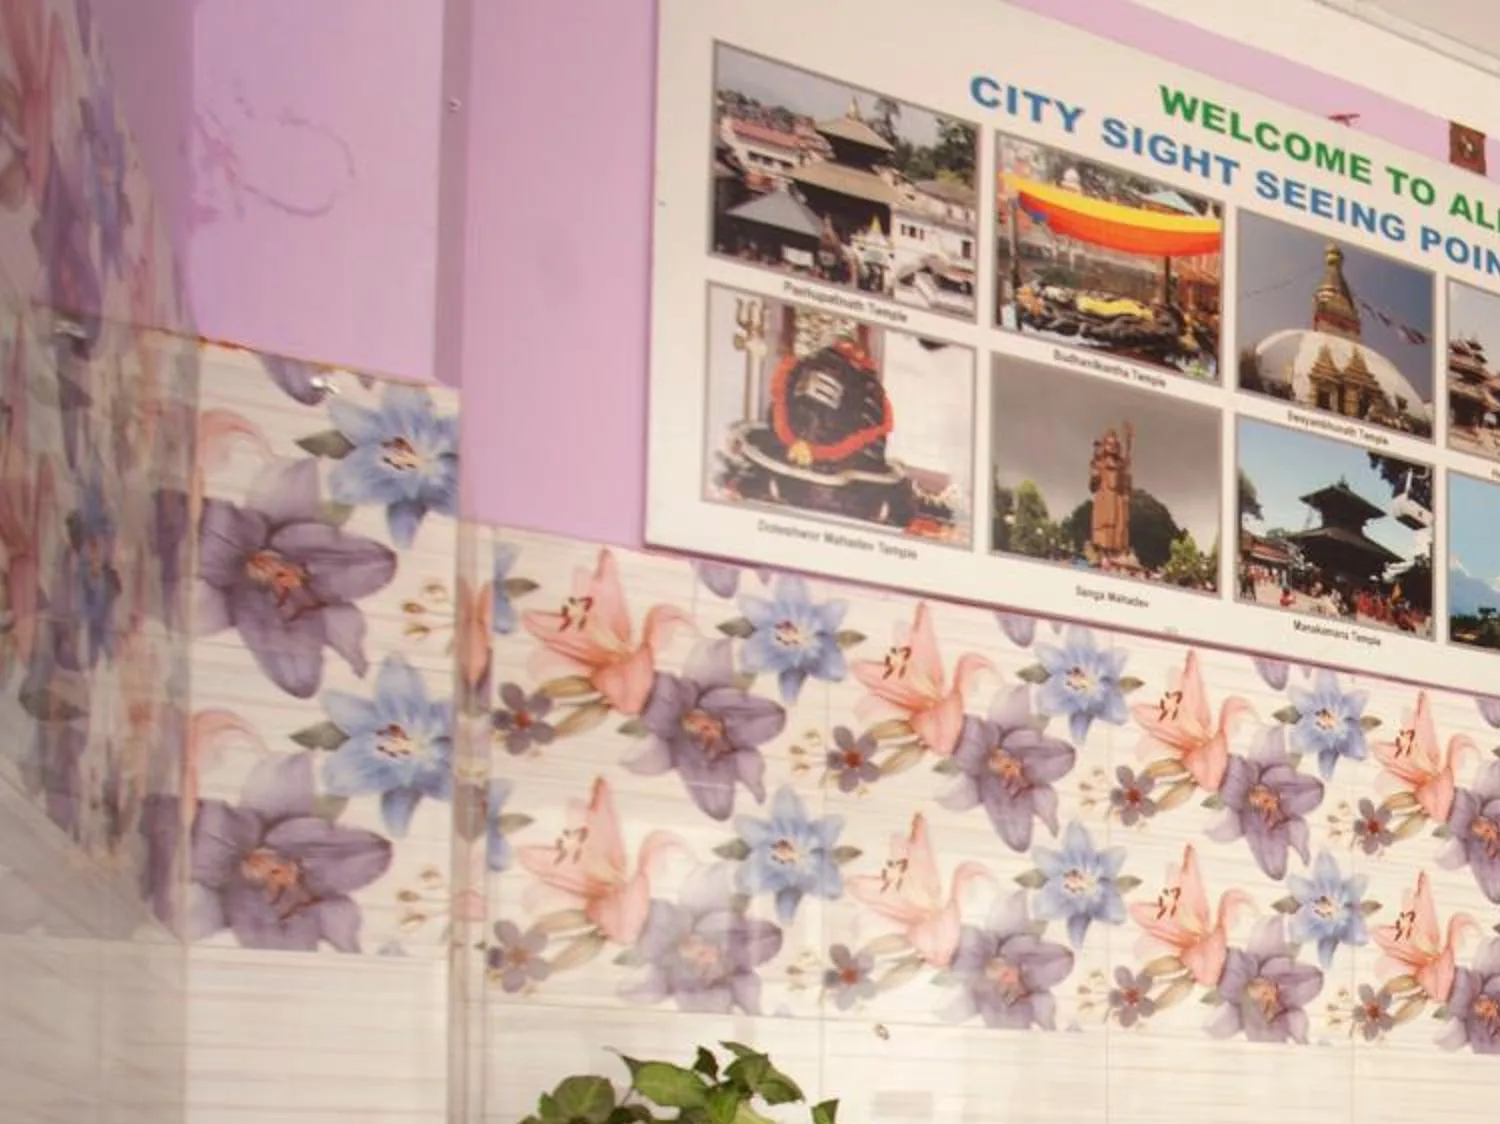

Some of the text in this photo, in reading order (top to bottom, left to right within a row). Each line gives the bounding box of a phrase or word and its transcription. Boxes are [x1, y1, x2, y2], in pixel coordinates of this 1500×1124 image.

[969, 76, 1086, 133] CITY
[1102, 117, 1240, 185] SIGHT
[1255, 170, 1406, 242] SEEING
[1159, 84, 1373, 185] WELCOME
[1385, 167, 1436, 207] TO
[877, 540, 918, 560] Temple
